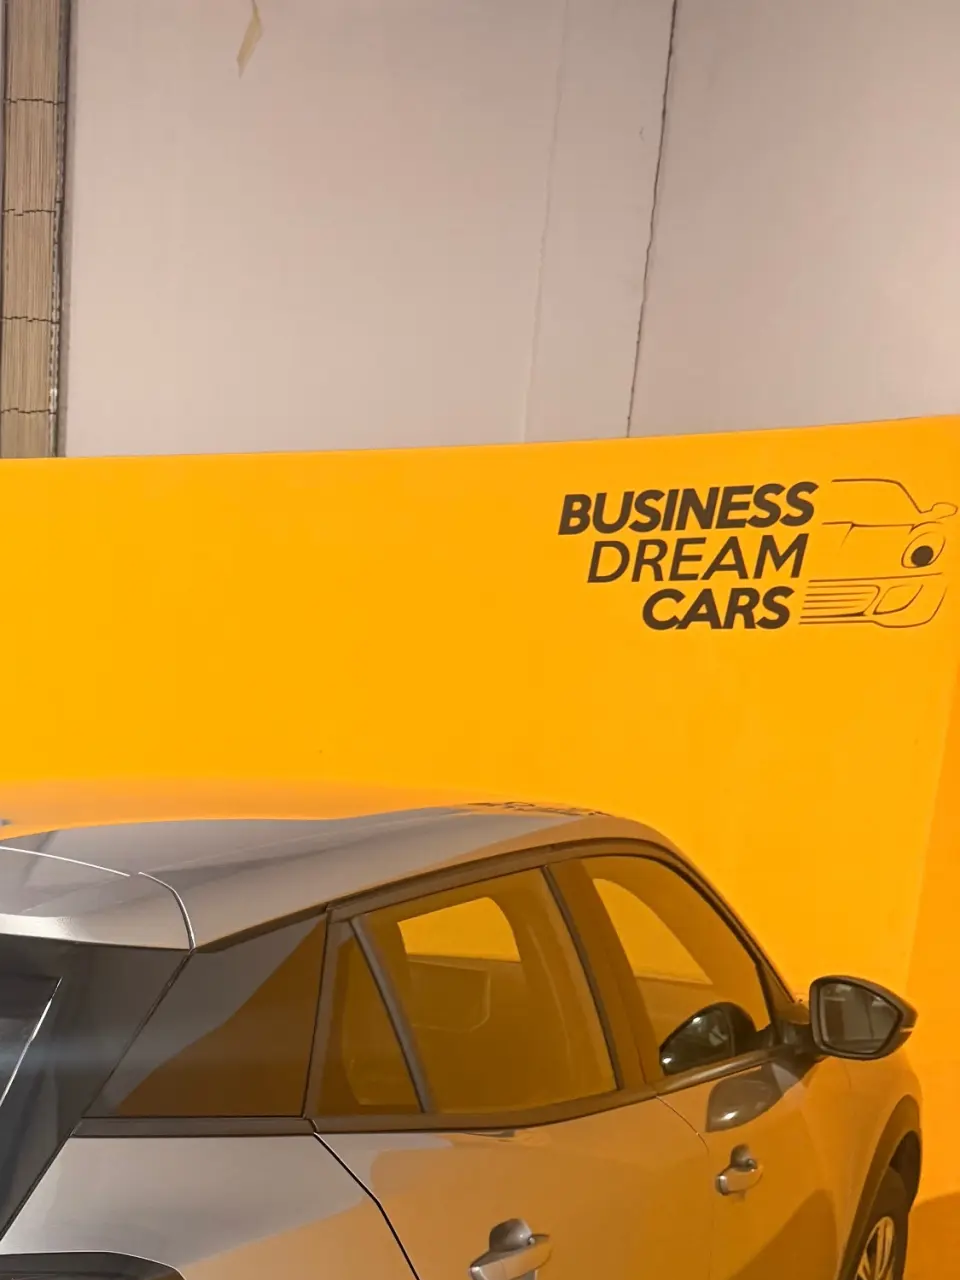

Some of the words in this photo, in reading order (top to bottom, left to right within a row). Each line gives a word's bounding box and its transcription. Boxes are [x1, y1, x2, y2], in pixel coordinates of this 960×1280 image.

[558, 481, 819, 535] BUSINESS
[587, 533, 809, 583] DREAM
[642, 585, 795, 631] CARS
